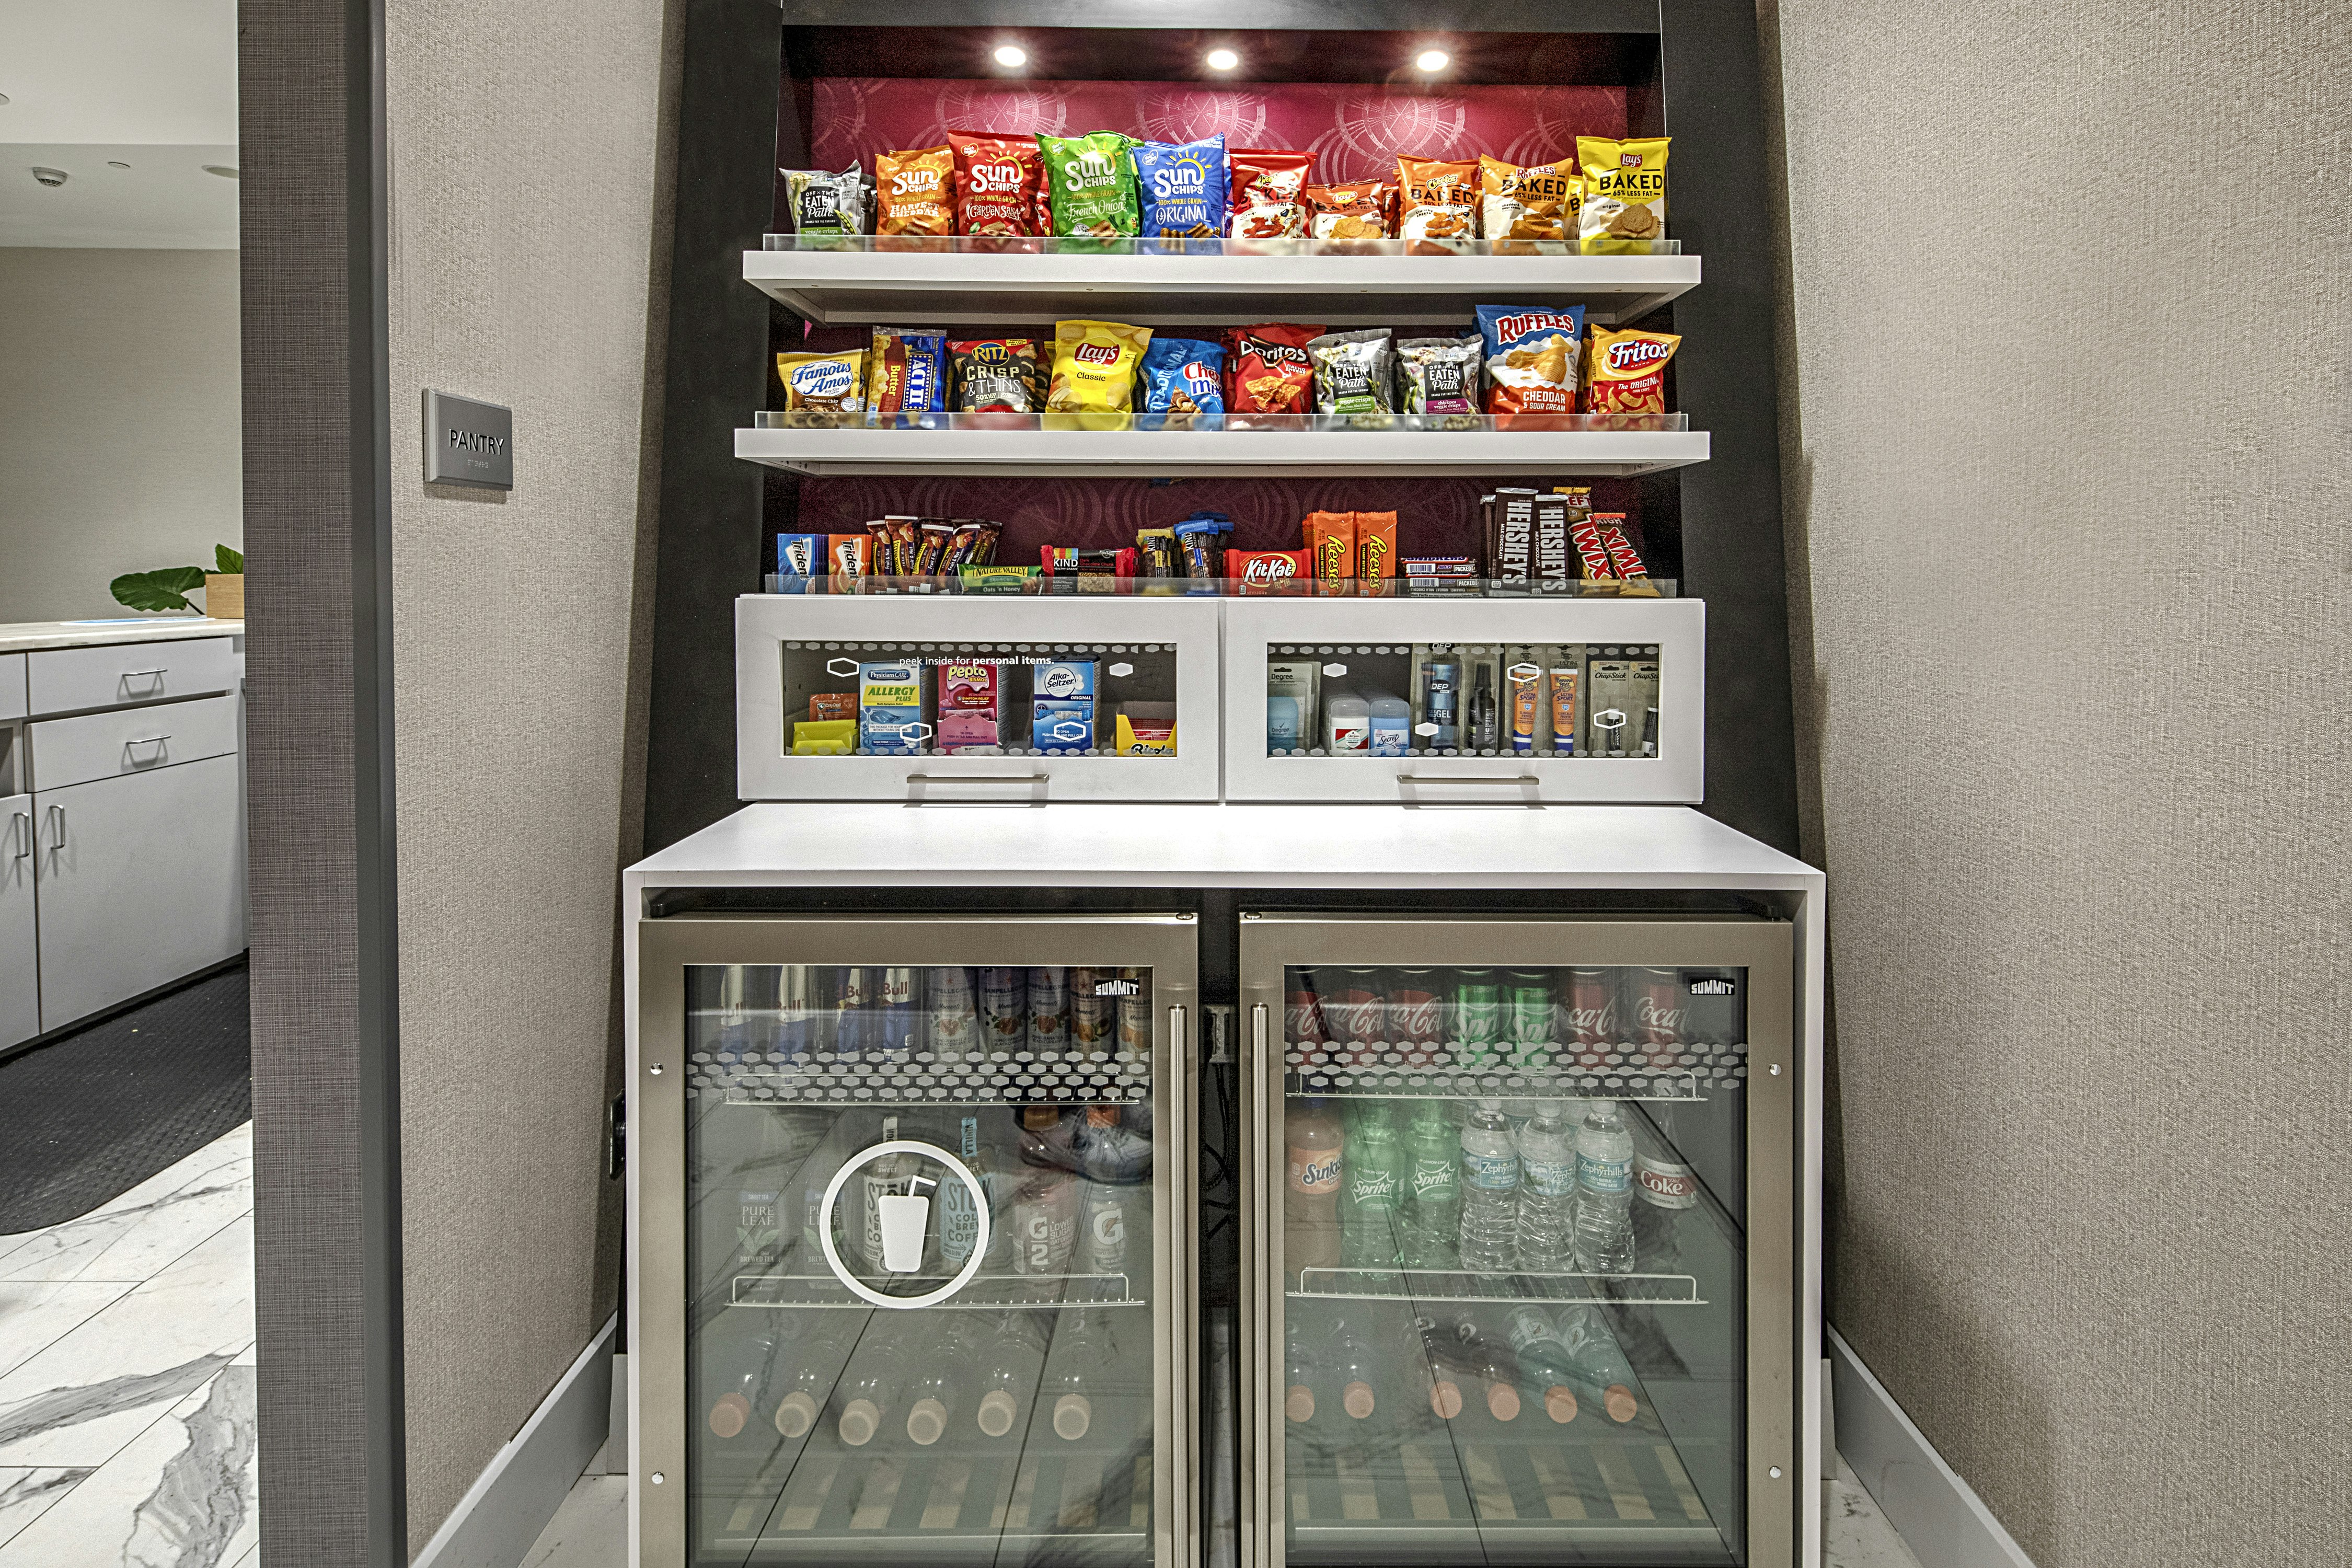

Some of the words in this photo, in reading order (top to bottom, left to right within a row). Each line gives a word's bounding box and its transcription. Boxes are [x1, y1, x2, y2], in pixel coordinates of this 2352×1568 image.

[1622, 154, 1642, 167] Lay's
[891, 169, 943, 195] Sun
[970, 163, 1023, 193] Sun
[1065, 158, 1116, 192] Sun
[1084, 176, 1116, 188] CHIPS
[1154, 167, 1205, 198] Sun
[1427, 175, 1458, 190] Cheetos
[1599, 174, 1663, 191] BAKED
[907, 183, 939, 192] CHIPS
[988, 182, 1020, 193] CHIPS
[1171, 185, 1204, 195] CHIPS
[1502, 178, 1567, 196] BAKED
[805, 195, 835, 207] EATEN
[1411, 188, 1474, 204] BAKED
[889, 208, 940, 217] CHEDDAR
[890, 201, 940, 212] HARVEST
[1067, 201, 1098, 221] French
[1099, 199, 1124, 214] Onion
[1156, 205, 1212, 225] ORIGINAL
[1497, 314, 1574, 343] RUFFLES
[974, 346, 1008, 362] RITZ
[1077, 343, 1118, 364] Lay's
[1240, 340, 1307, 362] Doritos
[1608, 340, 1668, 369] Fritos
[790, 362, 851, 385] Famous
[888, 365, 901, 396] Butter
[910, 359, 927, 387] ACT
[967, 365, 1020, 381] CRISP
[1077, 372, 1106, 382] Classic
[1150, 349, 1187, 410] TRADITIONAL
[1184, 362, 1220, 383] Chex
[1336, 366, 1367, 379] EATEN
[1429, 369, 1460, 381] EATEN
[803, 375, 854, 395] Amos
[968, 382, 976, 397] &
[975, 378, 1021, 394] THINS
[1523, 391, 1566, 404] CHEDDAR
[1546, 403, 1566, 412] CREAM
[449, 429, 505, 455] PANTRY
[1147, 536, 1156, 552] KIND
[1185, 532, 1194, 551] KIND
[1502, 501, 1532, 584] HERSHEY'S
[1539, 509, 1567, 591] HERSHEY'S
[1569, 514, 1613, 580] TWIX
[791, 537, 810, 581] Trident
[841, 537, 860, 582] Trident
[1054, 559, 1078, 568] KIND
[1327, 534, 1346, 591] Reese's
[1369, 534, 1388, 591] Reese's
[976, 567, 1002, 577] NATURE
[1243, 559, 1293, 583] KitKat
[899, 656, 923, 667] peek
[925, 656, 953, 665] inside
[956, 656, 971, 665] for
[973, 656, 1019, 667] personal
[1021, 656, 1054, 665] items.
[948, 666, 987, 681] Pepto
[1048, 673, 1070, 682] Alka-
[868, 687, 916, 696] ALLERGY
[1436, 710, 1451, 718] GEL
[1379, 733, 1401, 744] Secret
[883, 981, 908, 996] Bull
[1096, 979, 1139, 996] SUMMIT
[1691, 980, 1734, 995] SUMMIT
[1580, 1159, 1623, 1177] Zephyrhills
[1414, 1170, 1451, 1186] Sprite
[1640, 1170, 1684, 1195] Coke
[1352, 1180, 1391, 1195] Sprite
[742, 1205, 775, 1216] PURE
[742, 1215, 775, 1226] LEAF
[1028, 1216, 1048, 1240] G
[1092, 1207, 1124, 1246] G
[1031, 1243, 1049, 1266] 2
